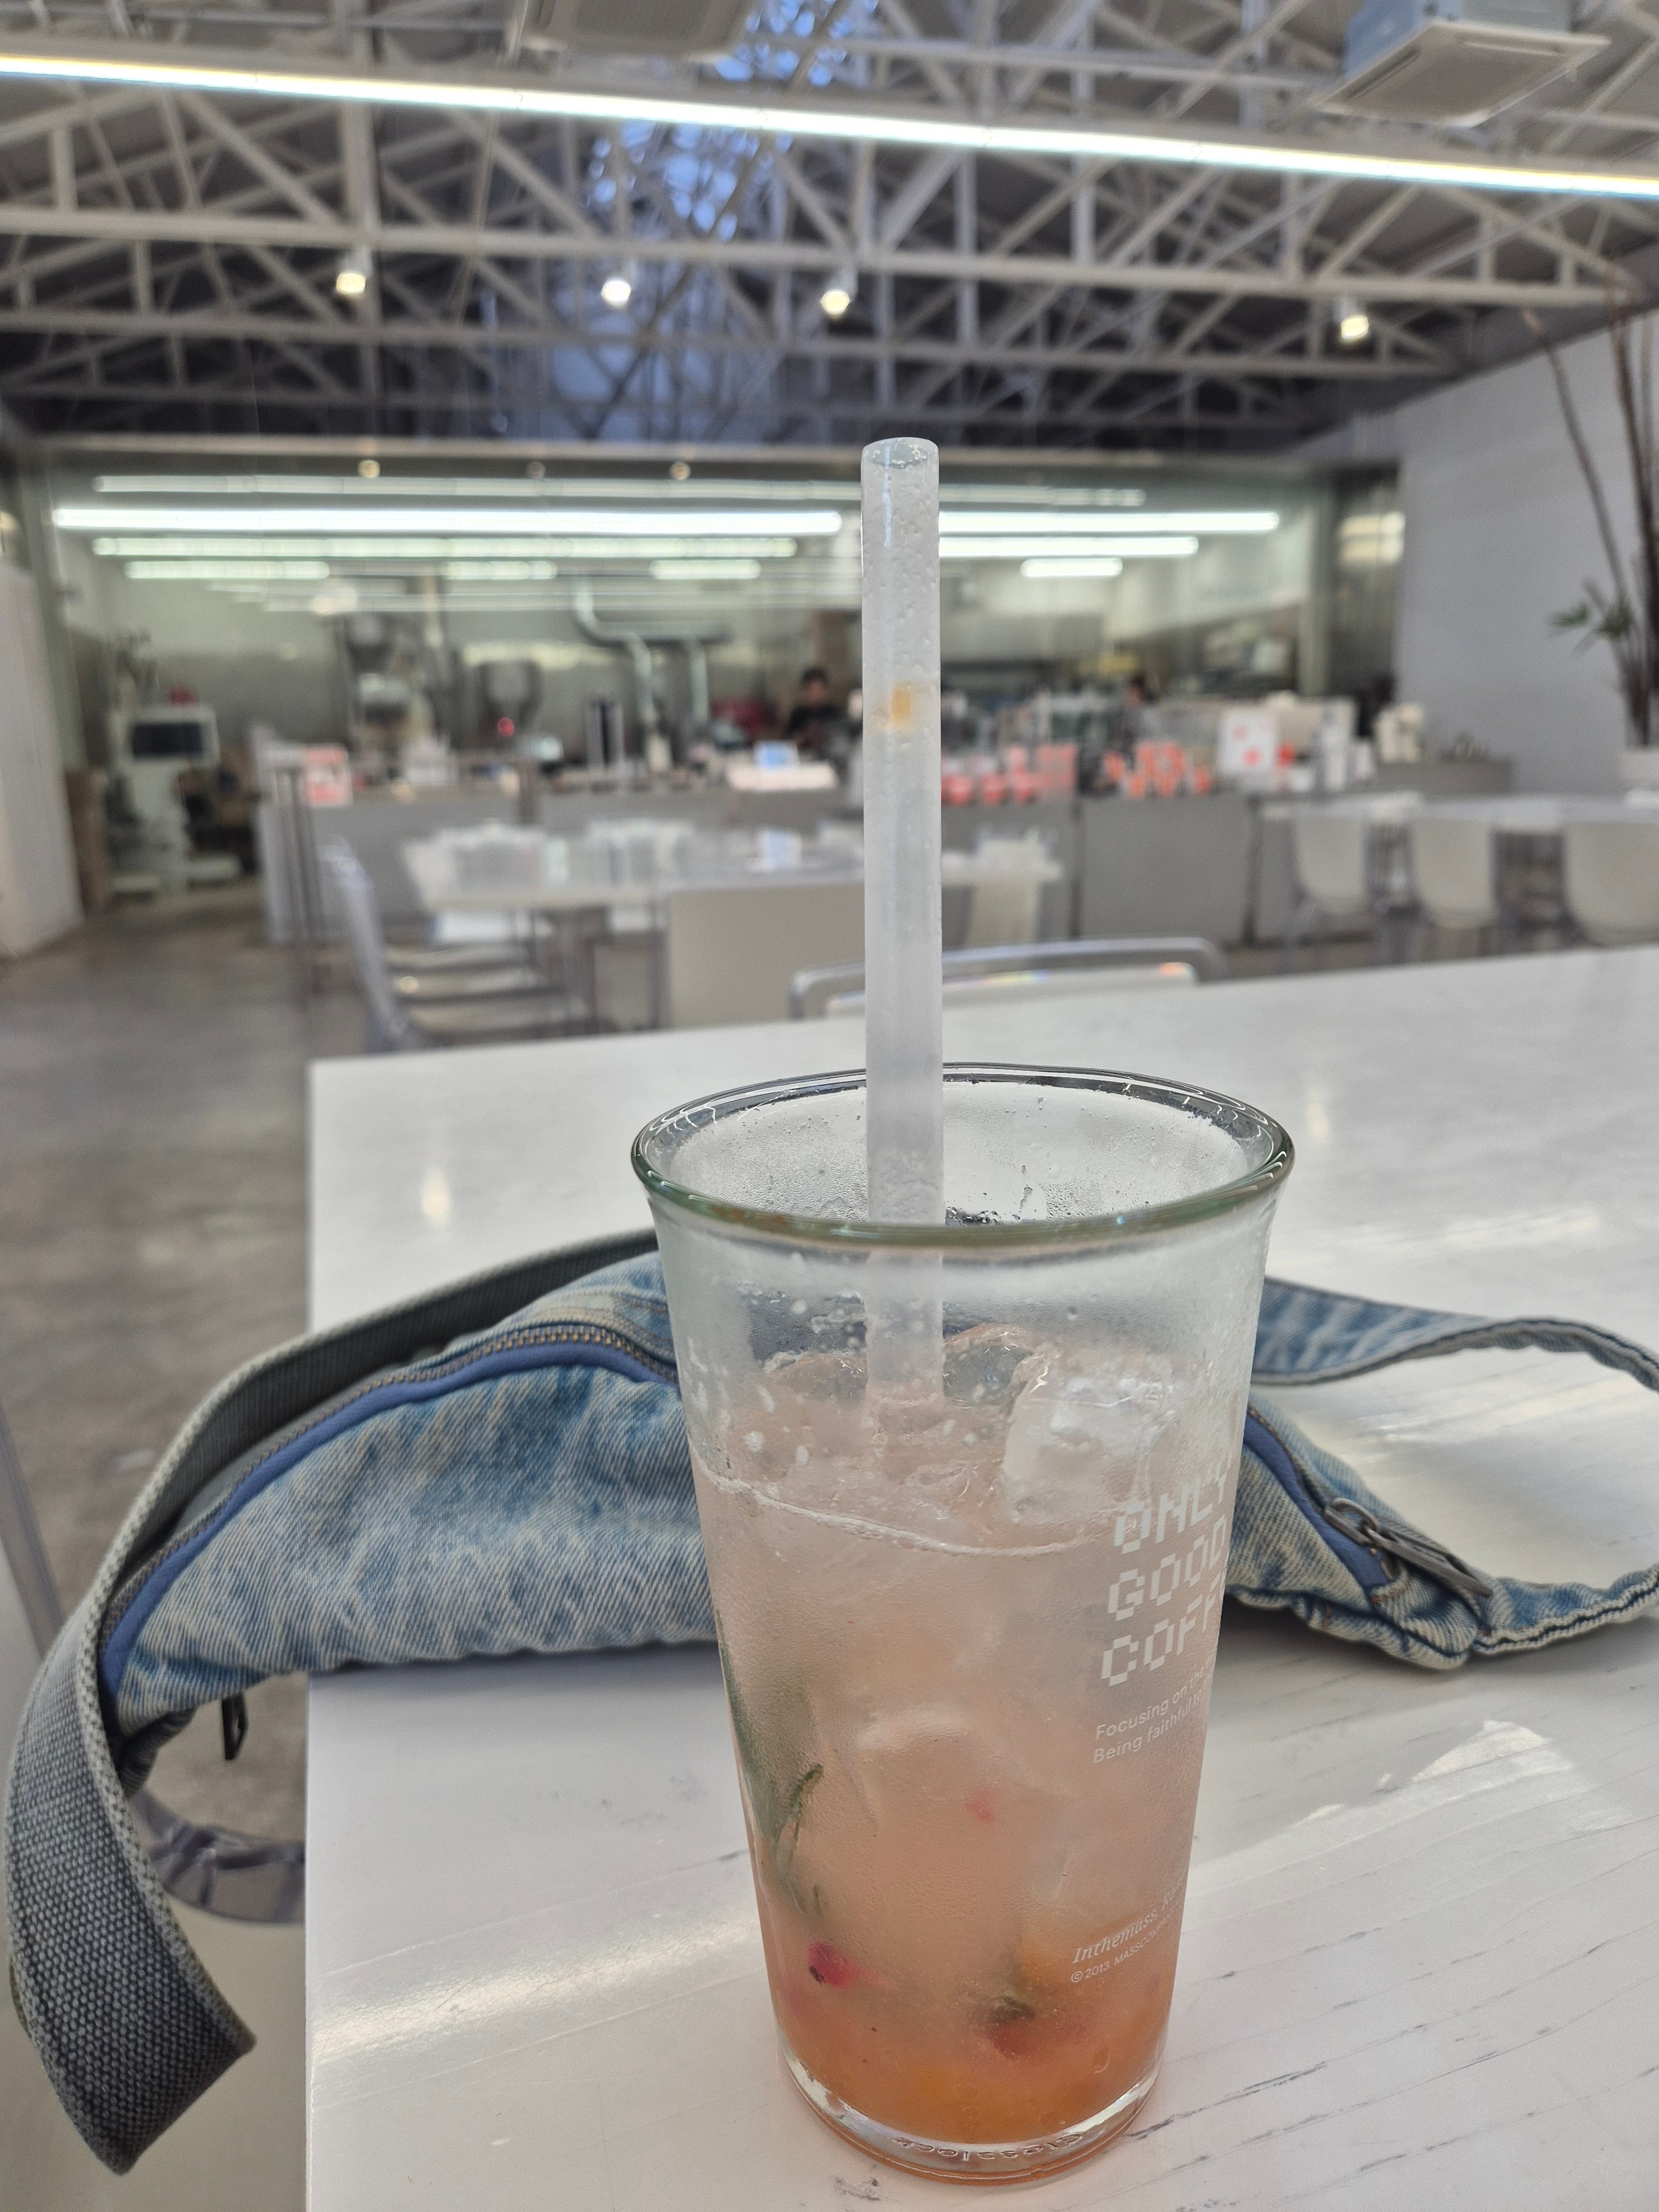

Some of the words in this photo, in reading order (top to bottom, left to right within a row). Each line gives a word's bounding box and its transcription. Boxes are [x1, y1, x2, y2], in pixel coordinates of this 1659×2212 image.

[1114, 1450, 1232, 1553] ONLY
[1107, 1514, 1227, 1621] GOOD
[1093, 1736, 1142, 1764] Being
[1147, 1696, 1192, 1742] faithful
[1094, 1699, 1169, 1740] Focusing
[1172, 1685, 1188, 1704] on
